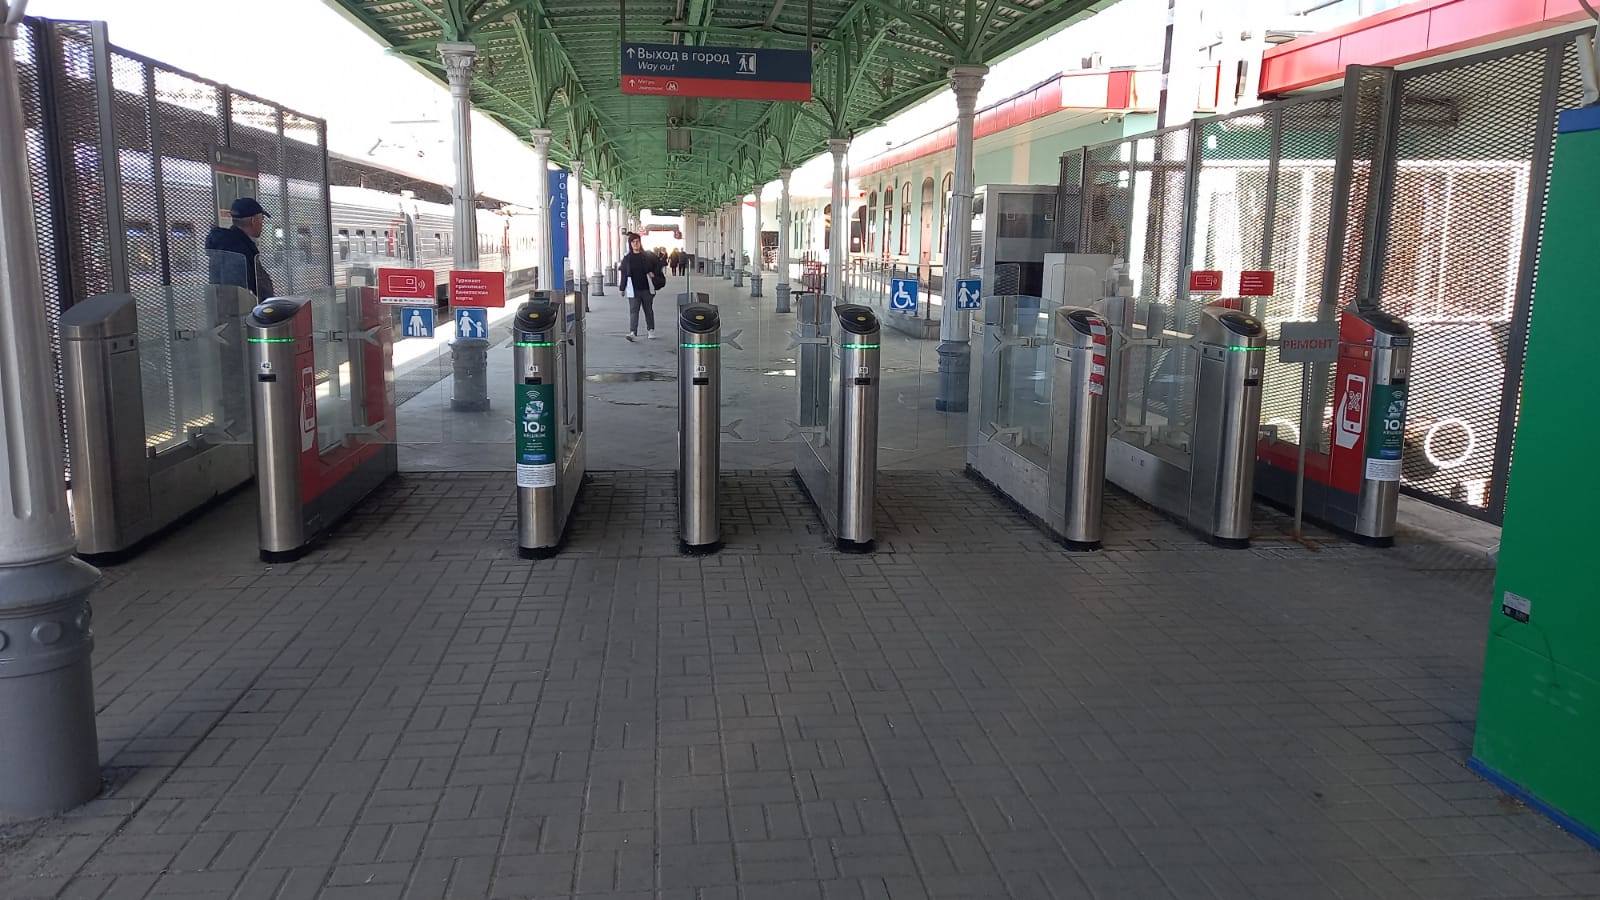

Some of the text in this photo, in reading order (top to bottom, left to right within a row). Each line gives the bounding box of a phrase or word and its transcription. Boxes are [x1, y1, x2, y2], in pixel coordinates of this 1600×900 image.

[637, 47, 730, 64] Выход в город
[638, 61, 675, 71] Way out
[1283, 339, 1334, 349] РЕМОНТ
[522, 421, 540, 433] 10
[1383, 419, 1400, 430] 10
